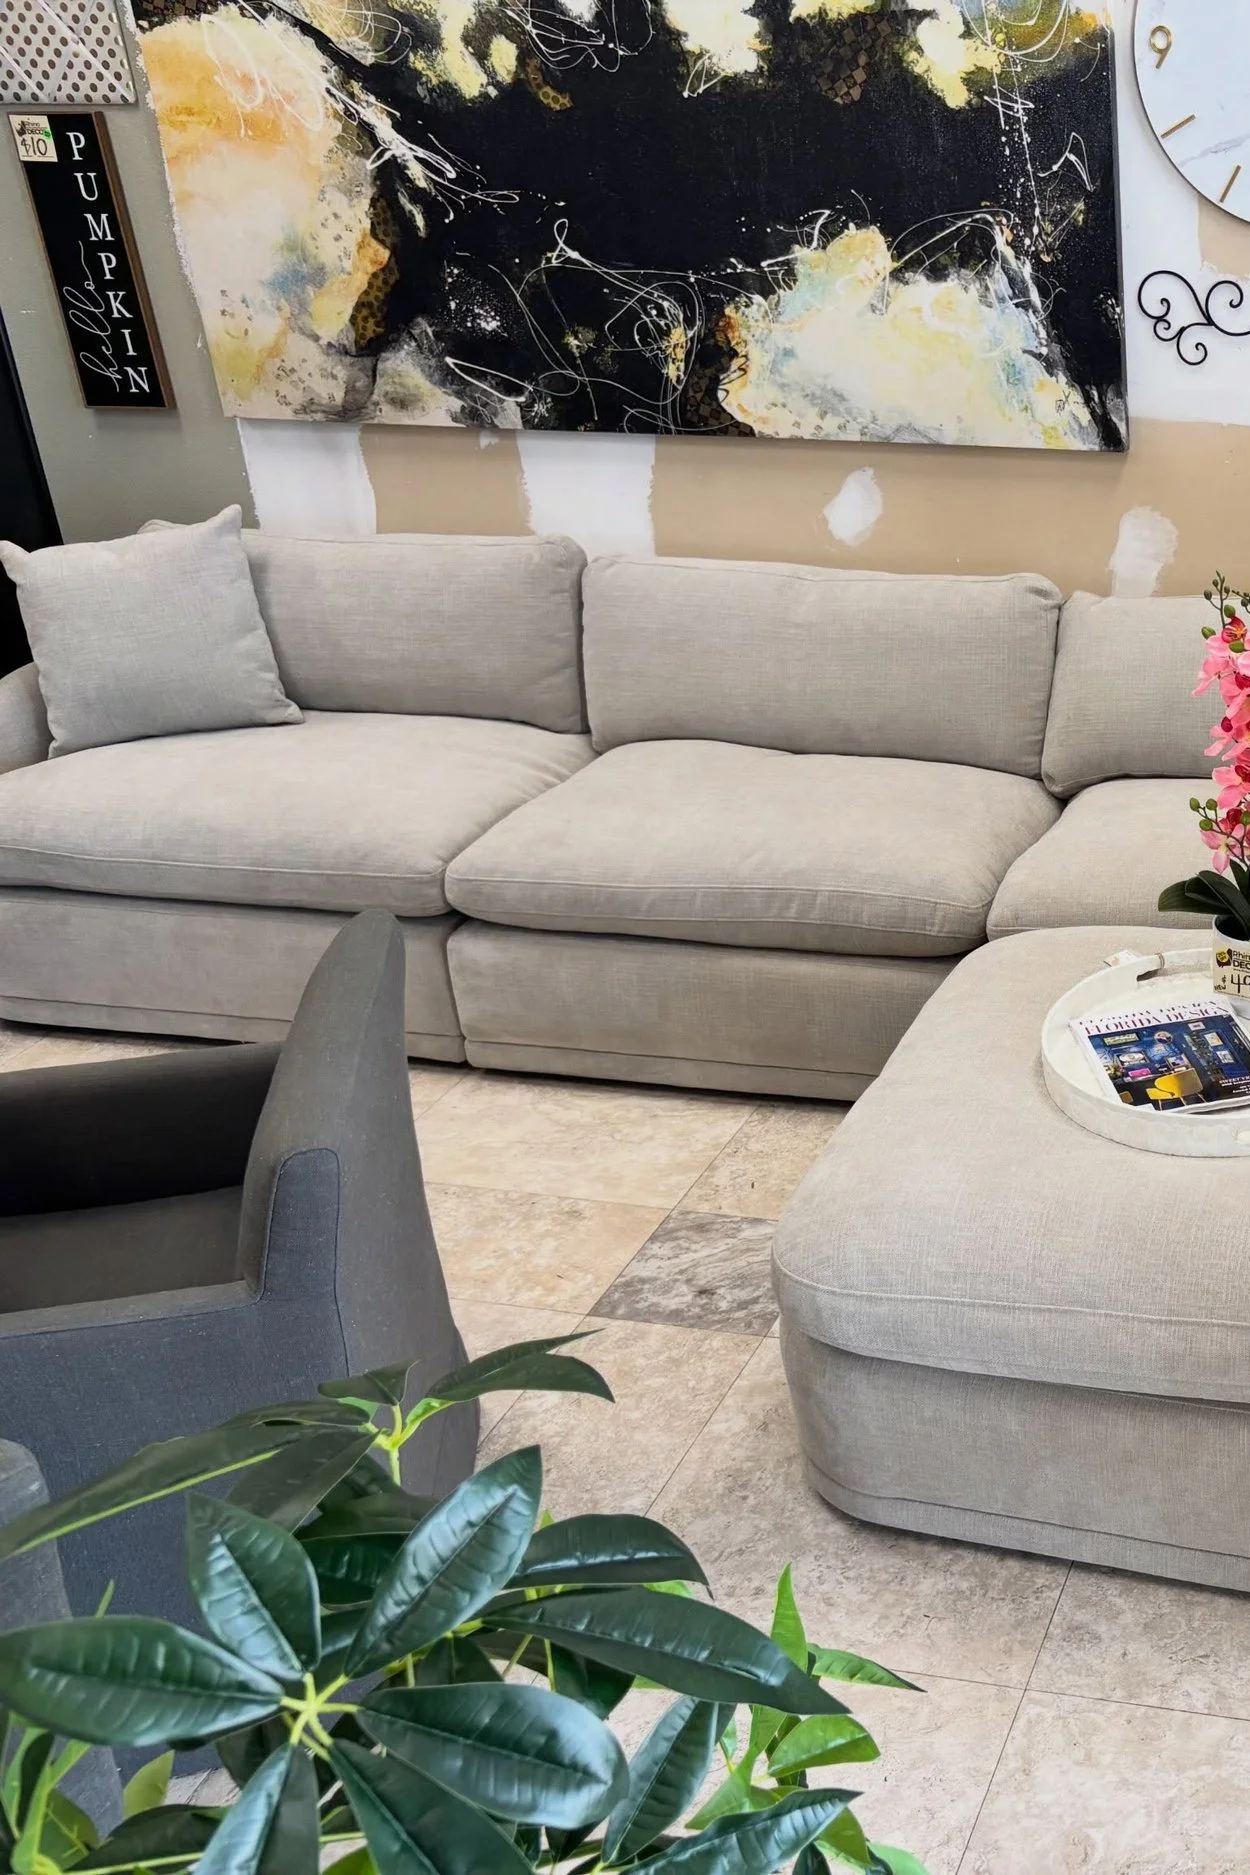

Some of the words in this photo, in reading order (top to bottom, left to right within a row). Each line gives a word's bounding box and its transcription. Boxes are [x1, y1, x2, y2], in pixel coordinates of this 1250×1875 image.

[1149, 25, 1172, 69] 9
[20, 136, 48, 156] $10
[65, 131, 150, 393] PUMPKIN
[62, 240, 123, 393] hello
[1084, 1015, 1162, 1035] FLORIDA
[1165, 1006, 1229, 1023] DESIGN
